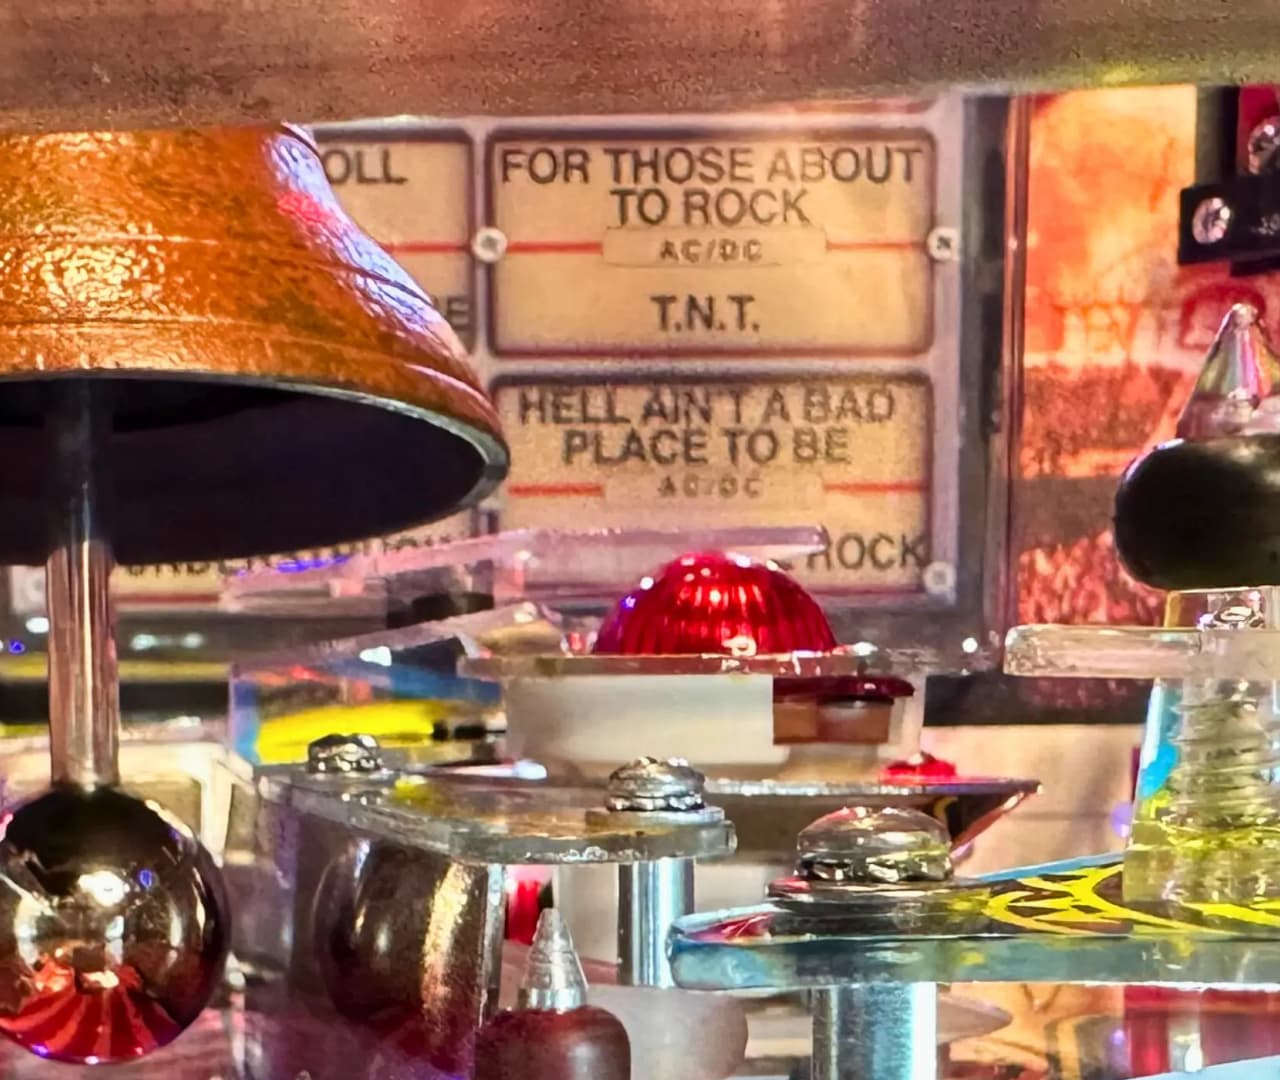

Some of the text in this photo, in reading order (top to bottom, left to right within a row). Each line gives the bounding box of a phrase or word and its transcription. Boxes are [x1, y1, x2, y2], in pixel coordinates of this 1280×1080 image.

[501, 147, 922, 184] FOR THOSE ABOUT
[610, 188, 812, 226] TO ROCK
[658, 239, 763, 262] AC/DC
[650, 295, 761, 332] T.N.T.
[520, 390, 630, 425] HELL
[762, 388, 792, 423] A
[802, 388, 897, 423] BAD
[562, 427, 851, 464] PLACE TO BE
